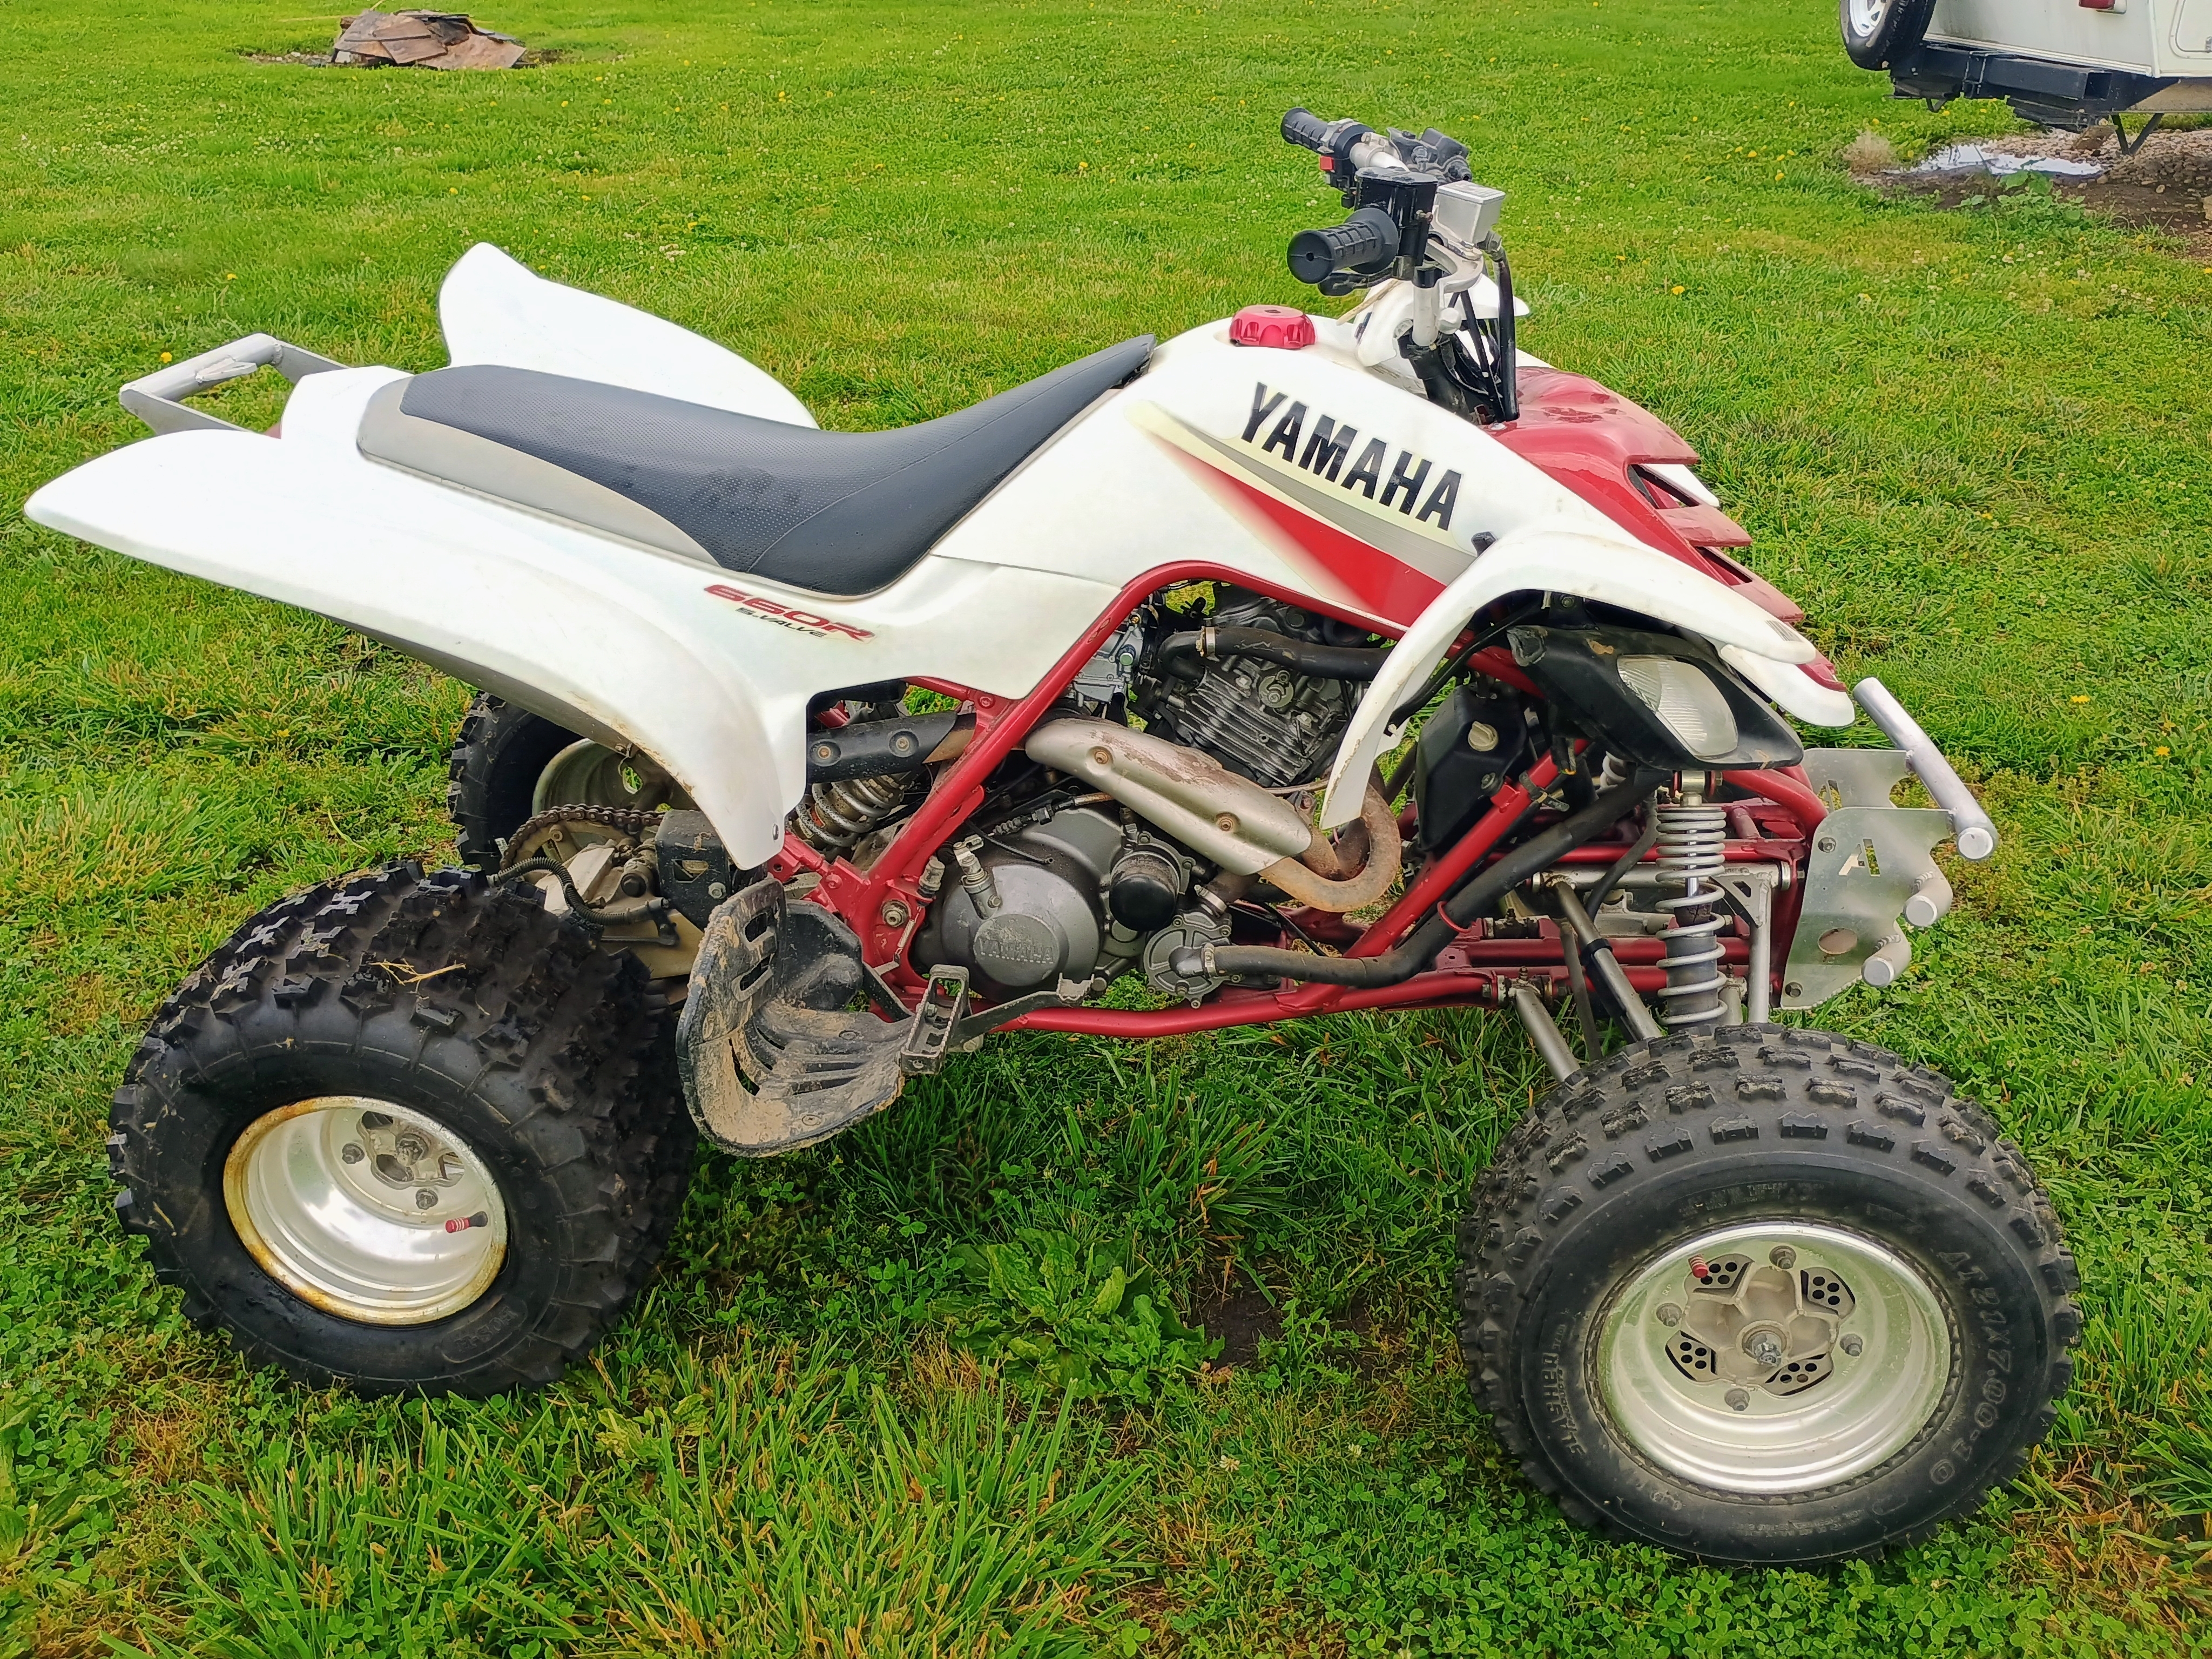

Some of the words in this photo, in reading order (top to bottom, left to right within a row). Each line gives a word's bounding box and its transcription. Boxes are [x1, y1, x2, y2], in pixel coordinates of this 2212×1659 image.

[1240, 381, 1462, 531] YAMAHA
[704, 584, 876, 643] 660R
[979, 937, 1054, 963] YAMAHA
